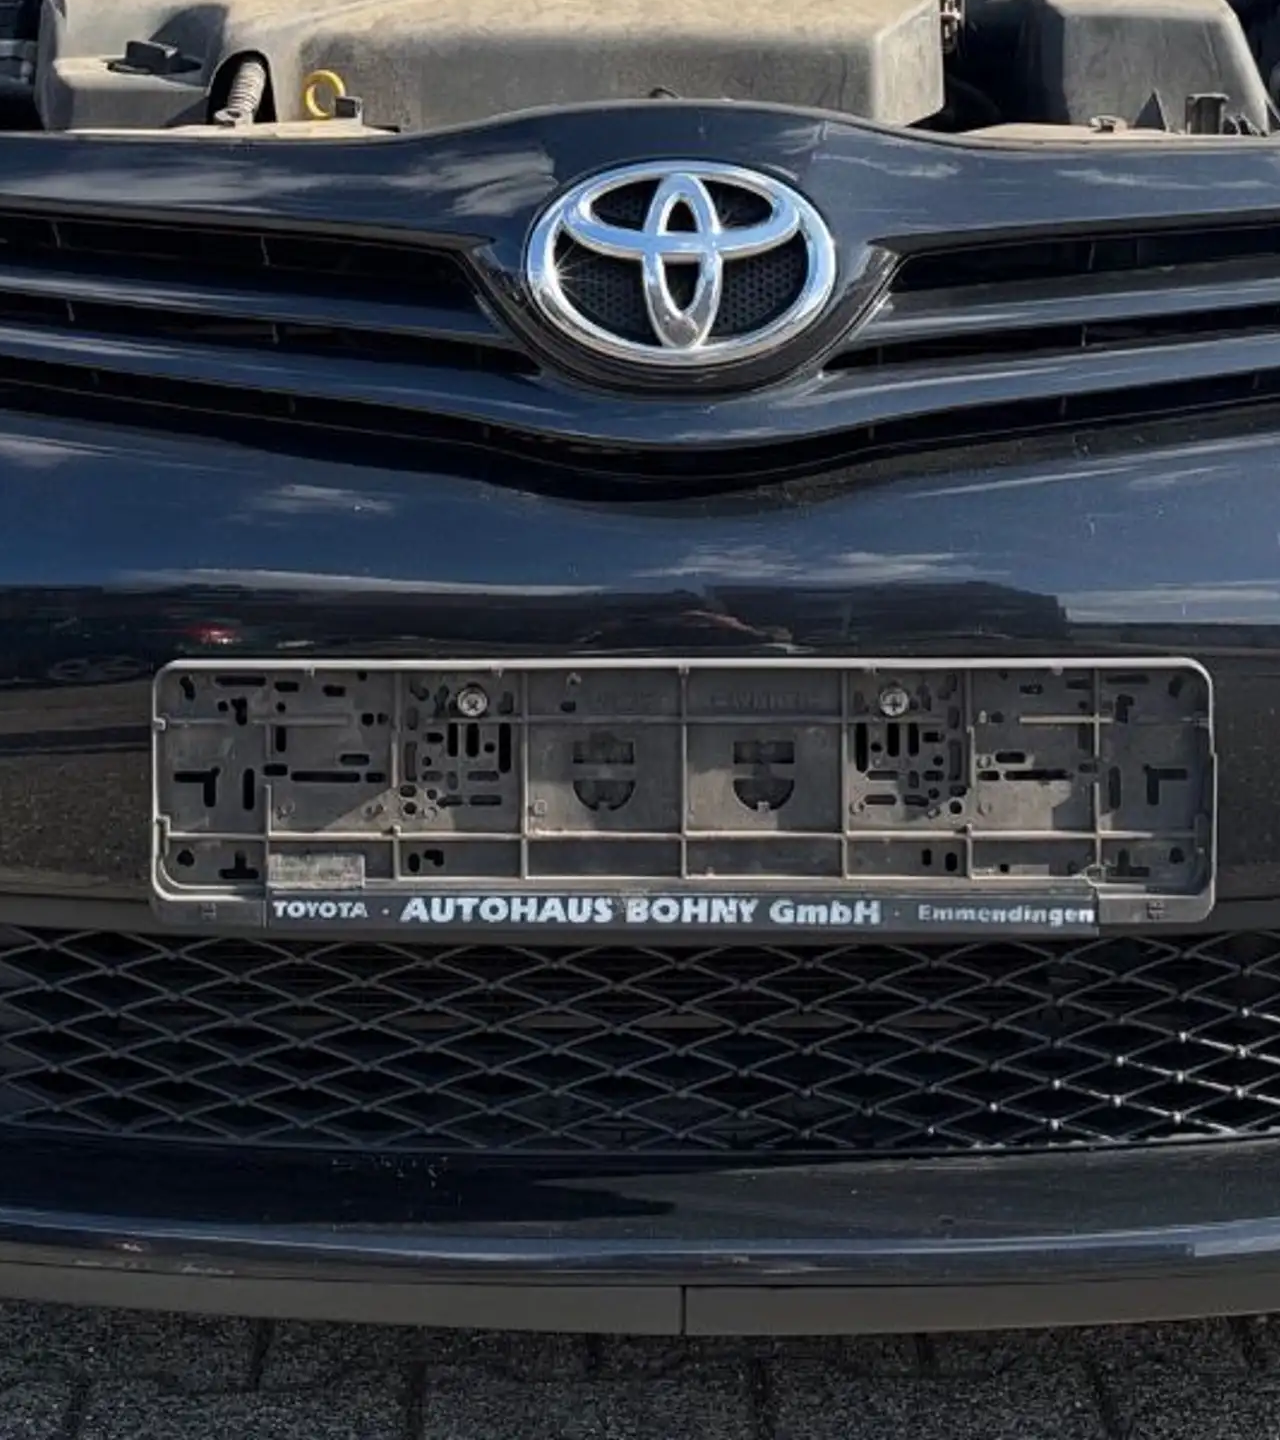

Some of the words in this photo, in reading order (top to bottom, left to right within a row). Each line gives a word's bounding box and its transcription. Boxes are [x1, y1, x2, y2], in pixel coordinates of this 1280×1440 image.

[273, 901, 368, 918] TOYOTA
[400, 897, 613, 924] AUTOHAUS
[625, 897, 759, 924] BOHNY
[770, 899, 881, 925] GmbH
[918, 904, 1094, 926] Emmendingen
